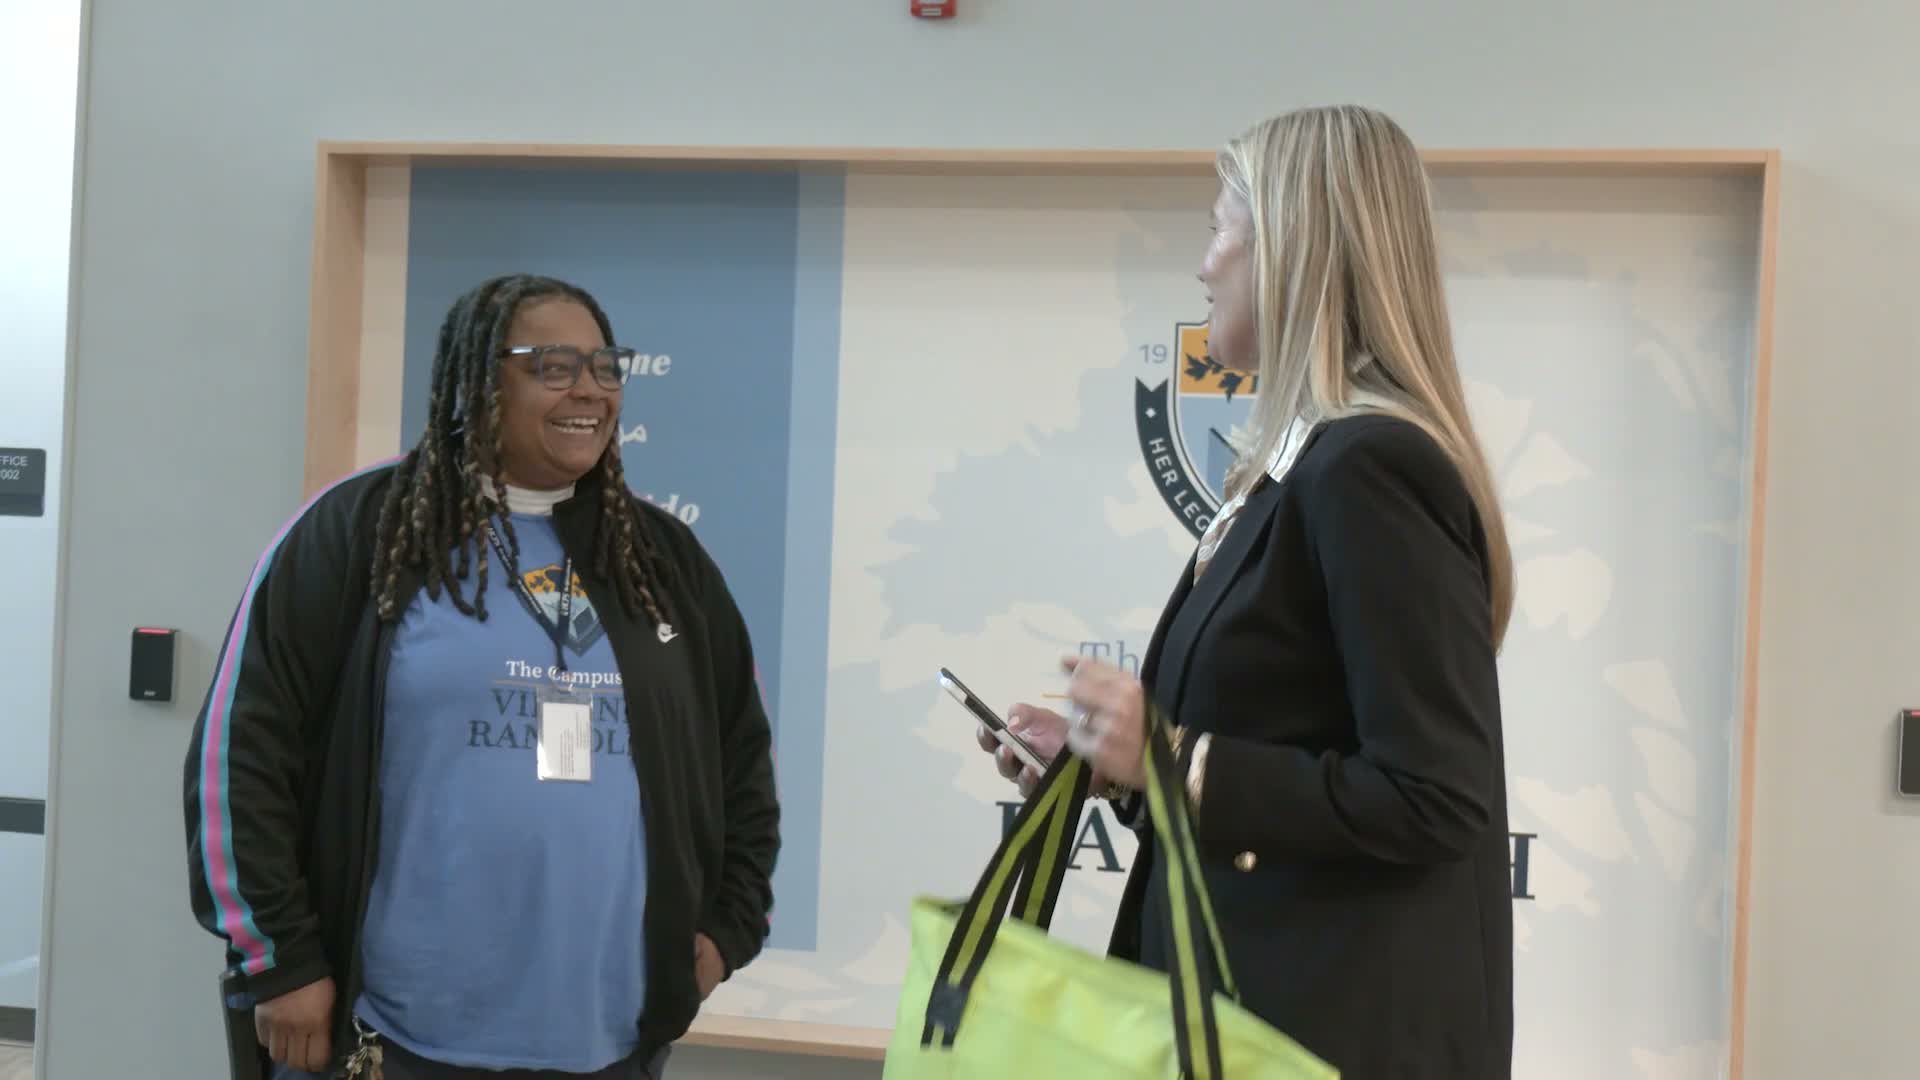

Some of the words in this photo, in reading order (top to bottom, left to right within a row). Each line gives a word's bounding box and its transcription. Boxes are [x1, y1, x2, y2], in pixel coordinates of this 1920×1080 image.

[1139, 343, 1168, 364] 19
[1148, 436, 1179, 487] HER
[1173, 488, 1212, 533] LEG
[506, 660, 543, 678] The
[547, 665, 623, 688] Campus
